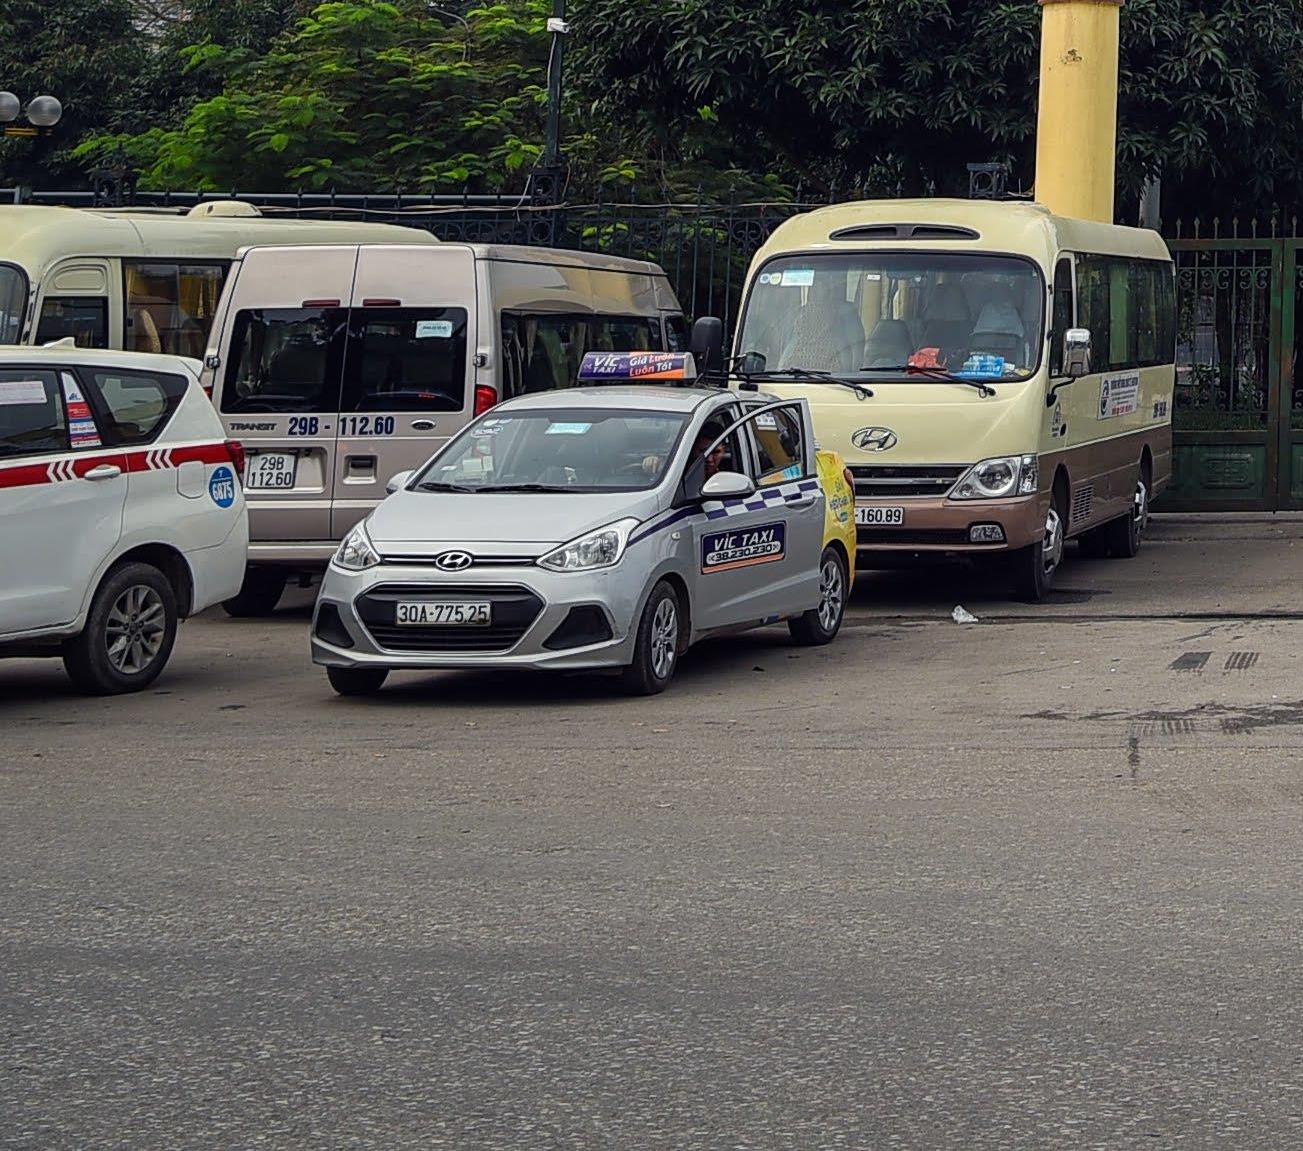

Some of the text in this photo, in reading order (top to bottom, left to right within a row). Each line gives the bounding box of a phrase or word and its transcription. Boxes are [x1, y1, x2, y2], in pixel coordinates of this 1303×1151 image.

[229, 422, 277, 431] TRANSIT
[287, 416, 319, 436] 29B
[338, 415, 395, 436] 112.60
[260, 456, 285, 471] 29B
[250, 471, 292, 487] 112.60
[212, 481, 233, 501] 6875
[742, 529, 775, 547] TAXI
[715, 544, 773, 562] 38.230.230
